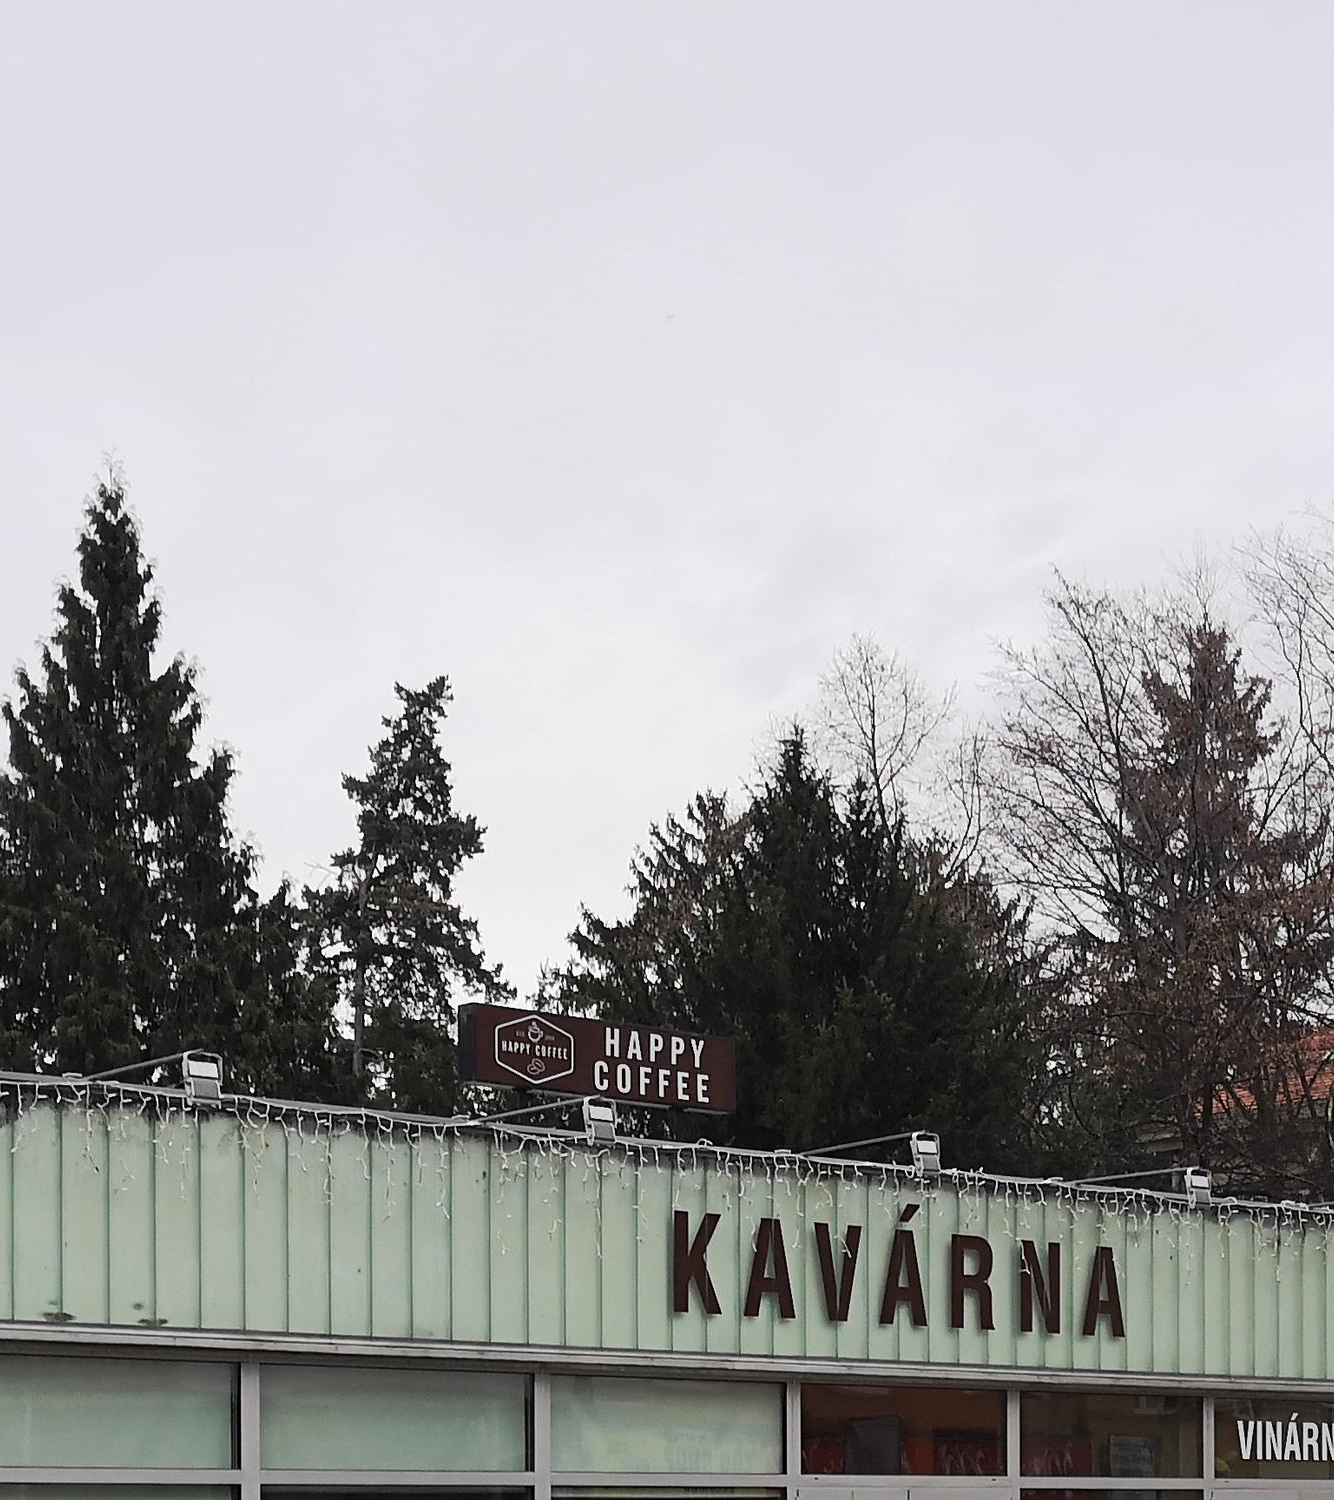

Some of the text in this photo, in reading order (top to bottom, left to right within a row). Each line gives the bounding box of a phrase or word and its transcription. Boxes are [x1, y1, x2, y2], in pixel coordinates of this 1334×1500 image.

[501, 1040, 568, 1060] HAPPY COFFEE
[605, 1027, 706, 1069] HAPPY
[593, 1060, 711, 1104] COFFEE
[672, 1203, 1127, 1339] KAVÁRNA
